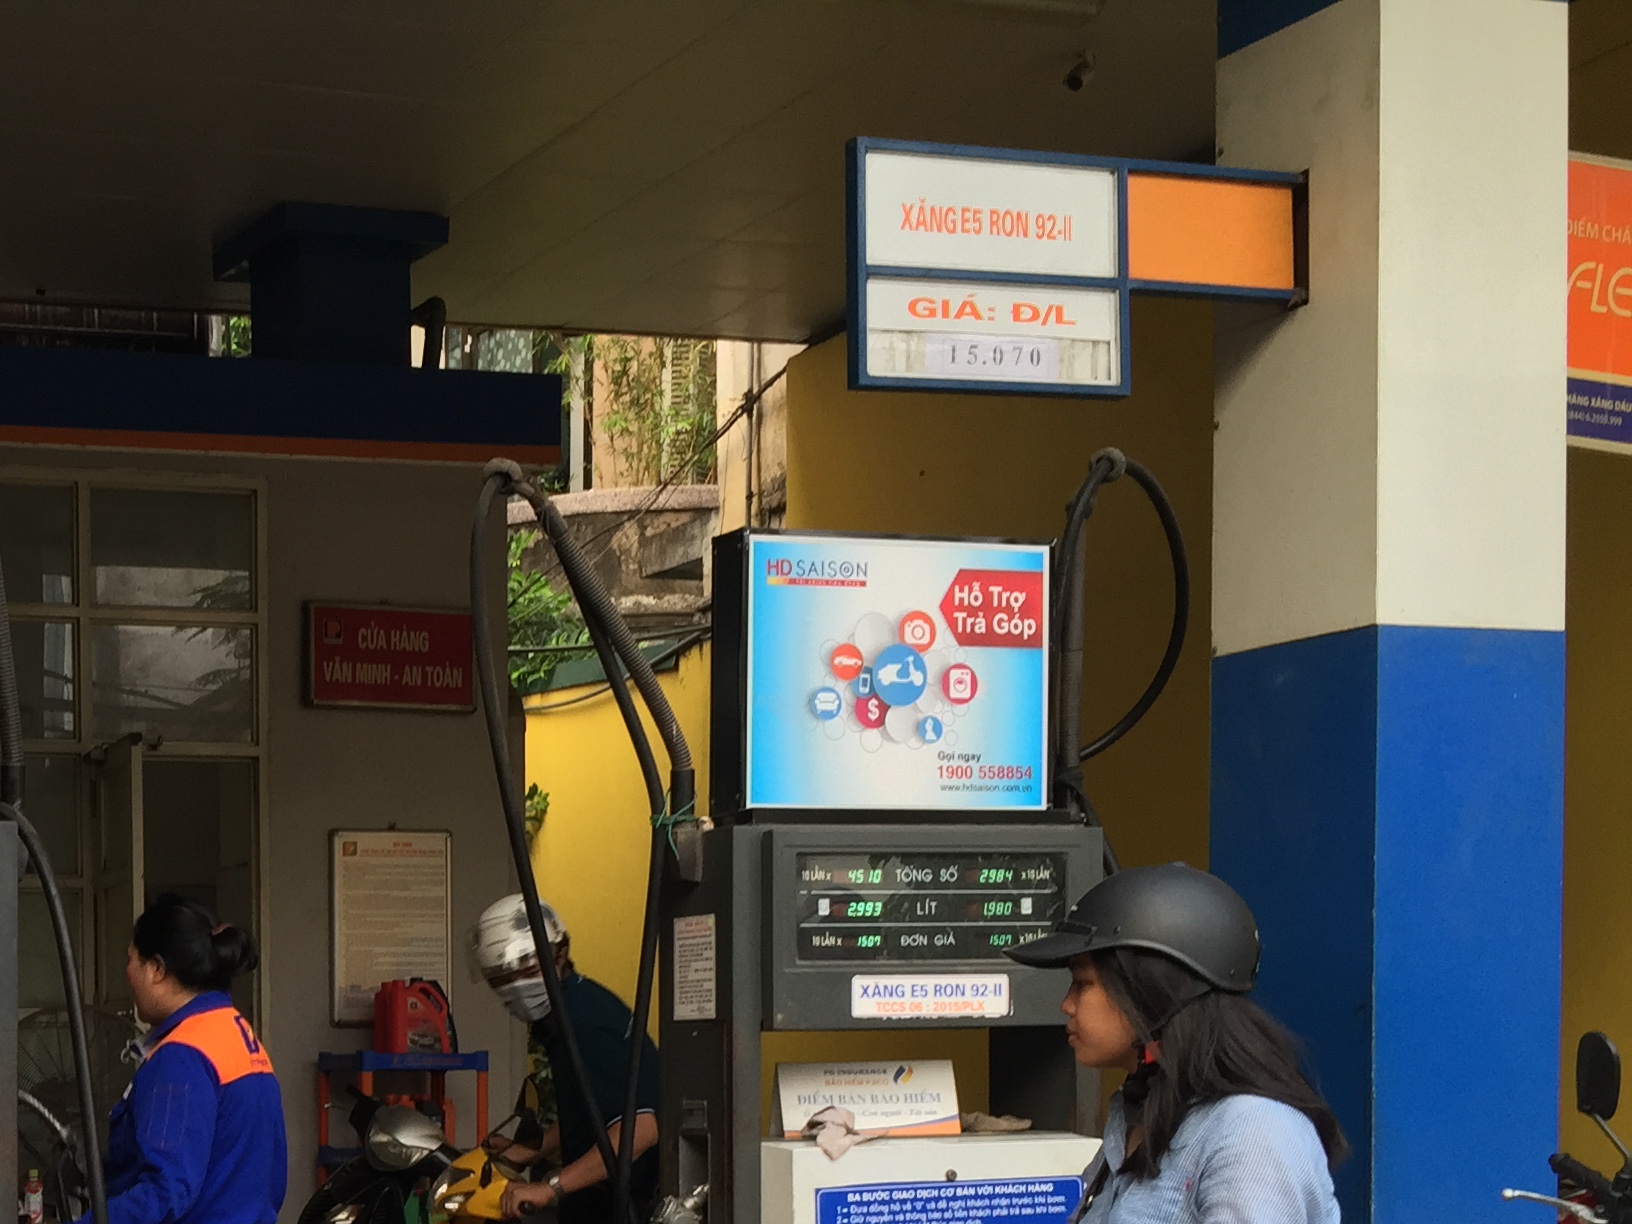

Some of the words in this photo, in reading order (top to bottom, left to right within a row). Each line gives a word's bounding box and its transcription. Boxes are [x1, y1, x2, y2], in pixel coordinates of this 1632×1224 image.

[901, 197, 957, 235] XĂNG
[961, 207, 982, 235] E5
[990, 208, 1030, 239] RON
[1035, 214, 1073, 241] 92-II
[908, 293, 996, 322] GIÁ:
[1011, 301, 1076, 326] Đ/L
[950, 344, 1041, 367] 15.070
[767, 558, 793, 577] HD
[796, 559, 868, 579] SAISON
[954, 582, 983, 606] Hỗ
[988, 587, 1026, 610] Trợ
[358, 622, 387, 649] CỬA
[391, 625, 429, 652] HÀNG
[953, 611, 986, 634] Trả
[992, 615, 1036, 640] Góp
[323, 656, 352, 684] VĂN
[356, 663, 391, 685] MINH
[402, 666, 421, 686] AN
[425, 662, 462, 688] TOÀN
[937, 751, 955, 762] Gọi
[958, 753, 981, 763] ngay
[937, 765, 972, 779] 1900
[979, 766, 1032, 780] 558854
[979, 868, 1013, 884] 2984
[860, 982, 905, 998] XĂNG
[911, 984, 928, 997] E5
[934, 984, 965, 997] RON
[971, 984, 1002, 997] 92-II
